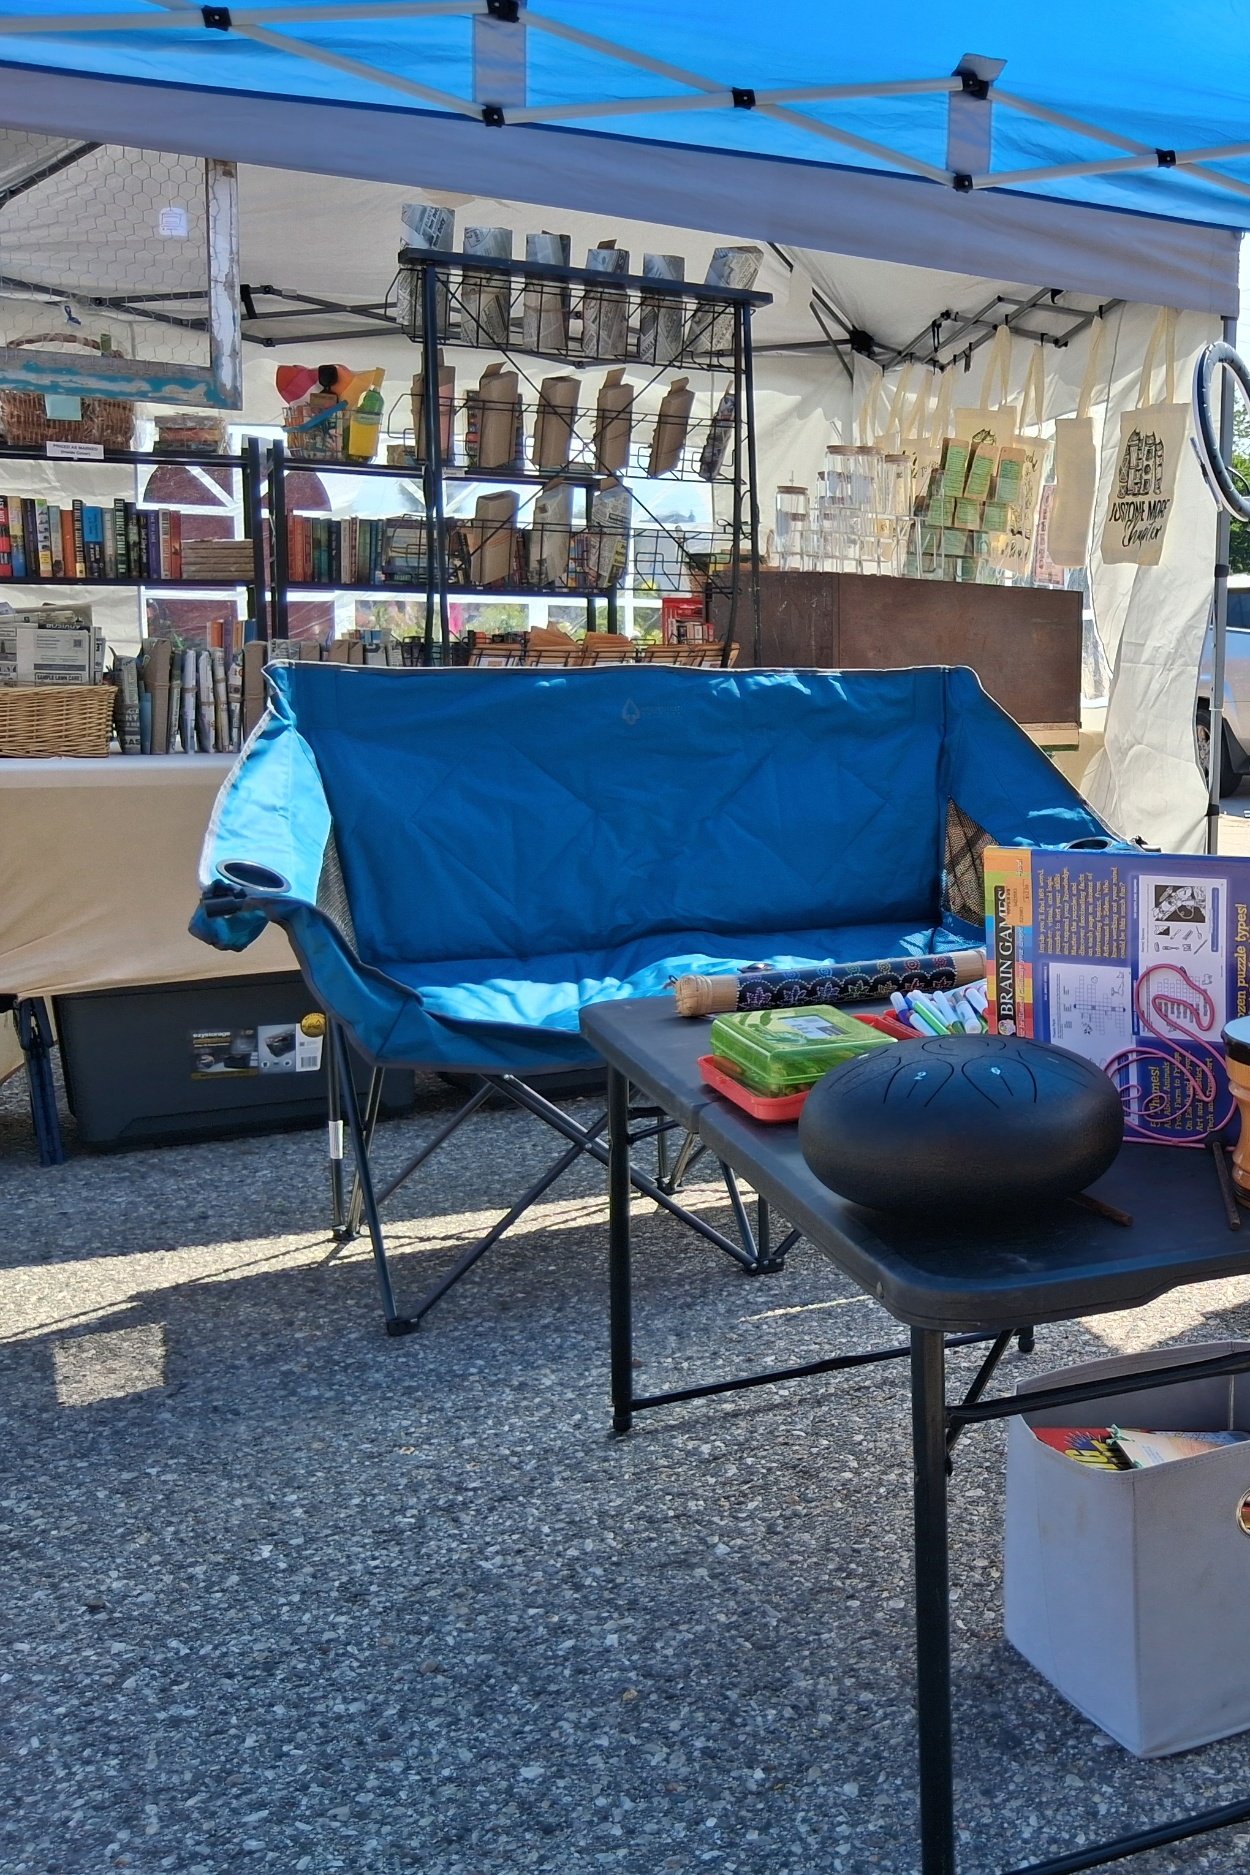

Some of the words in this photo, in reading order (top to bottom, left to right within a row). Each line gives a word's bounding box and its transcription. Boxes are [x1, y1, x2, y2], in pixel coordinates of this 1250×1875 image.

[115, 500, 124, 510] THE
[1108, 501, 1129, 523] JUST
[1128, 500, 1145, 522] ONE
[116, 511, 125, 534] MIRACLE
[1122, 517, 1162, 549] Chapter
[997, 890, 1014, 955] GAMES
[1234, 903, 1250, 942] types!
[1234, 945, 1249, 987] puzzle
[998, 959, 1015, 1016] BRAIN
[1236, 990, 1247, 1018] ozen
[192, 1030, 232, 1038] ezystorage
[1163, 1061, 1171, 1091] Animals
[1174, 1051, 1182, 1077] Frge
[1185, 1120, 1193, 1131] On
[1196, 1118, 1204, 1131] Art
[1206, 1114, 1214, 1132] Tech
